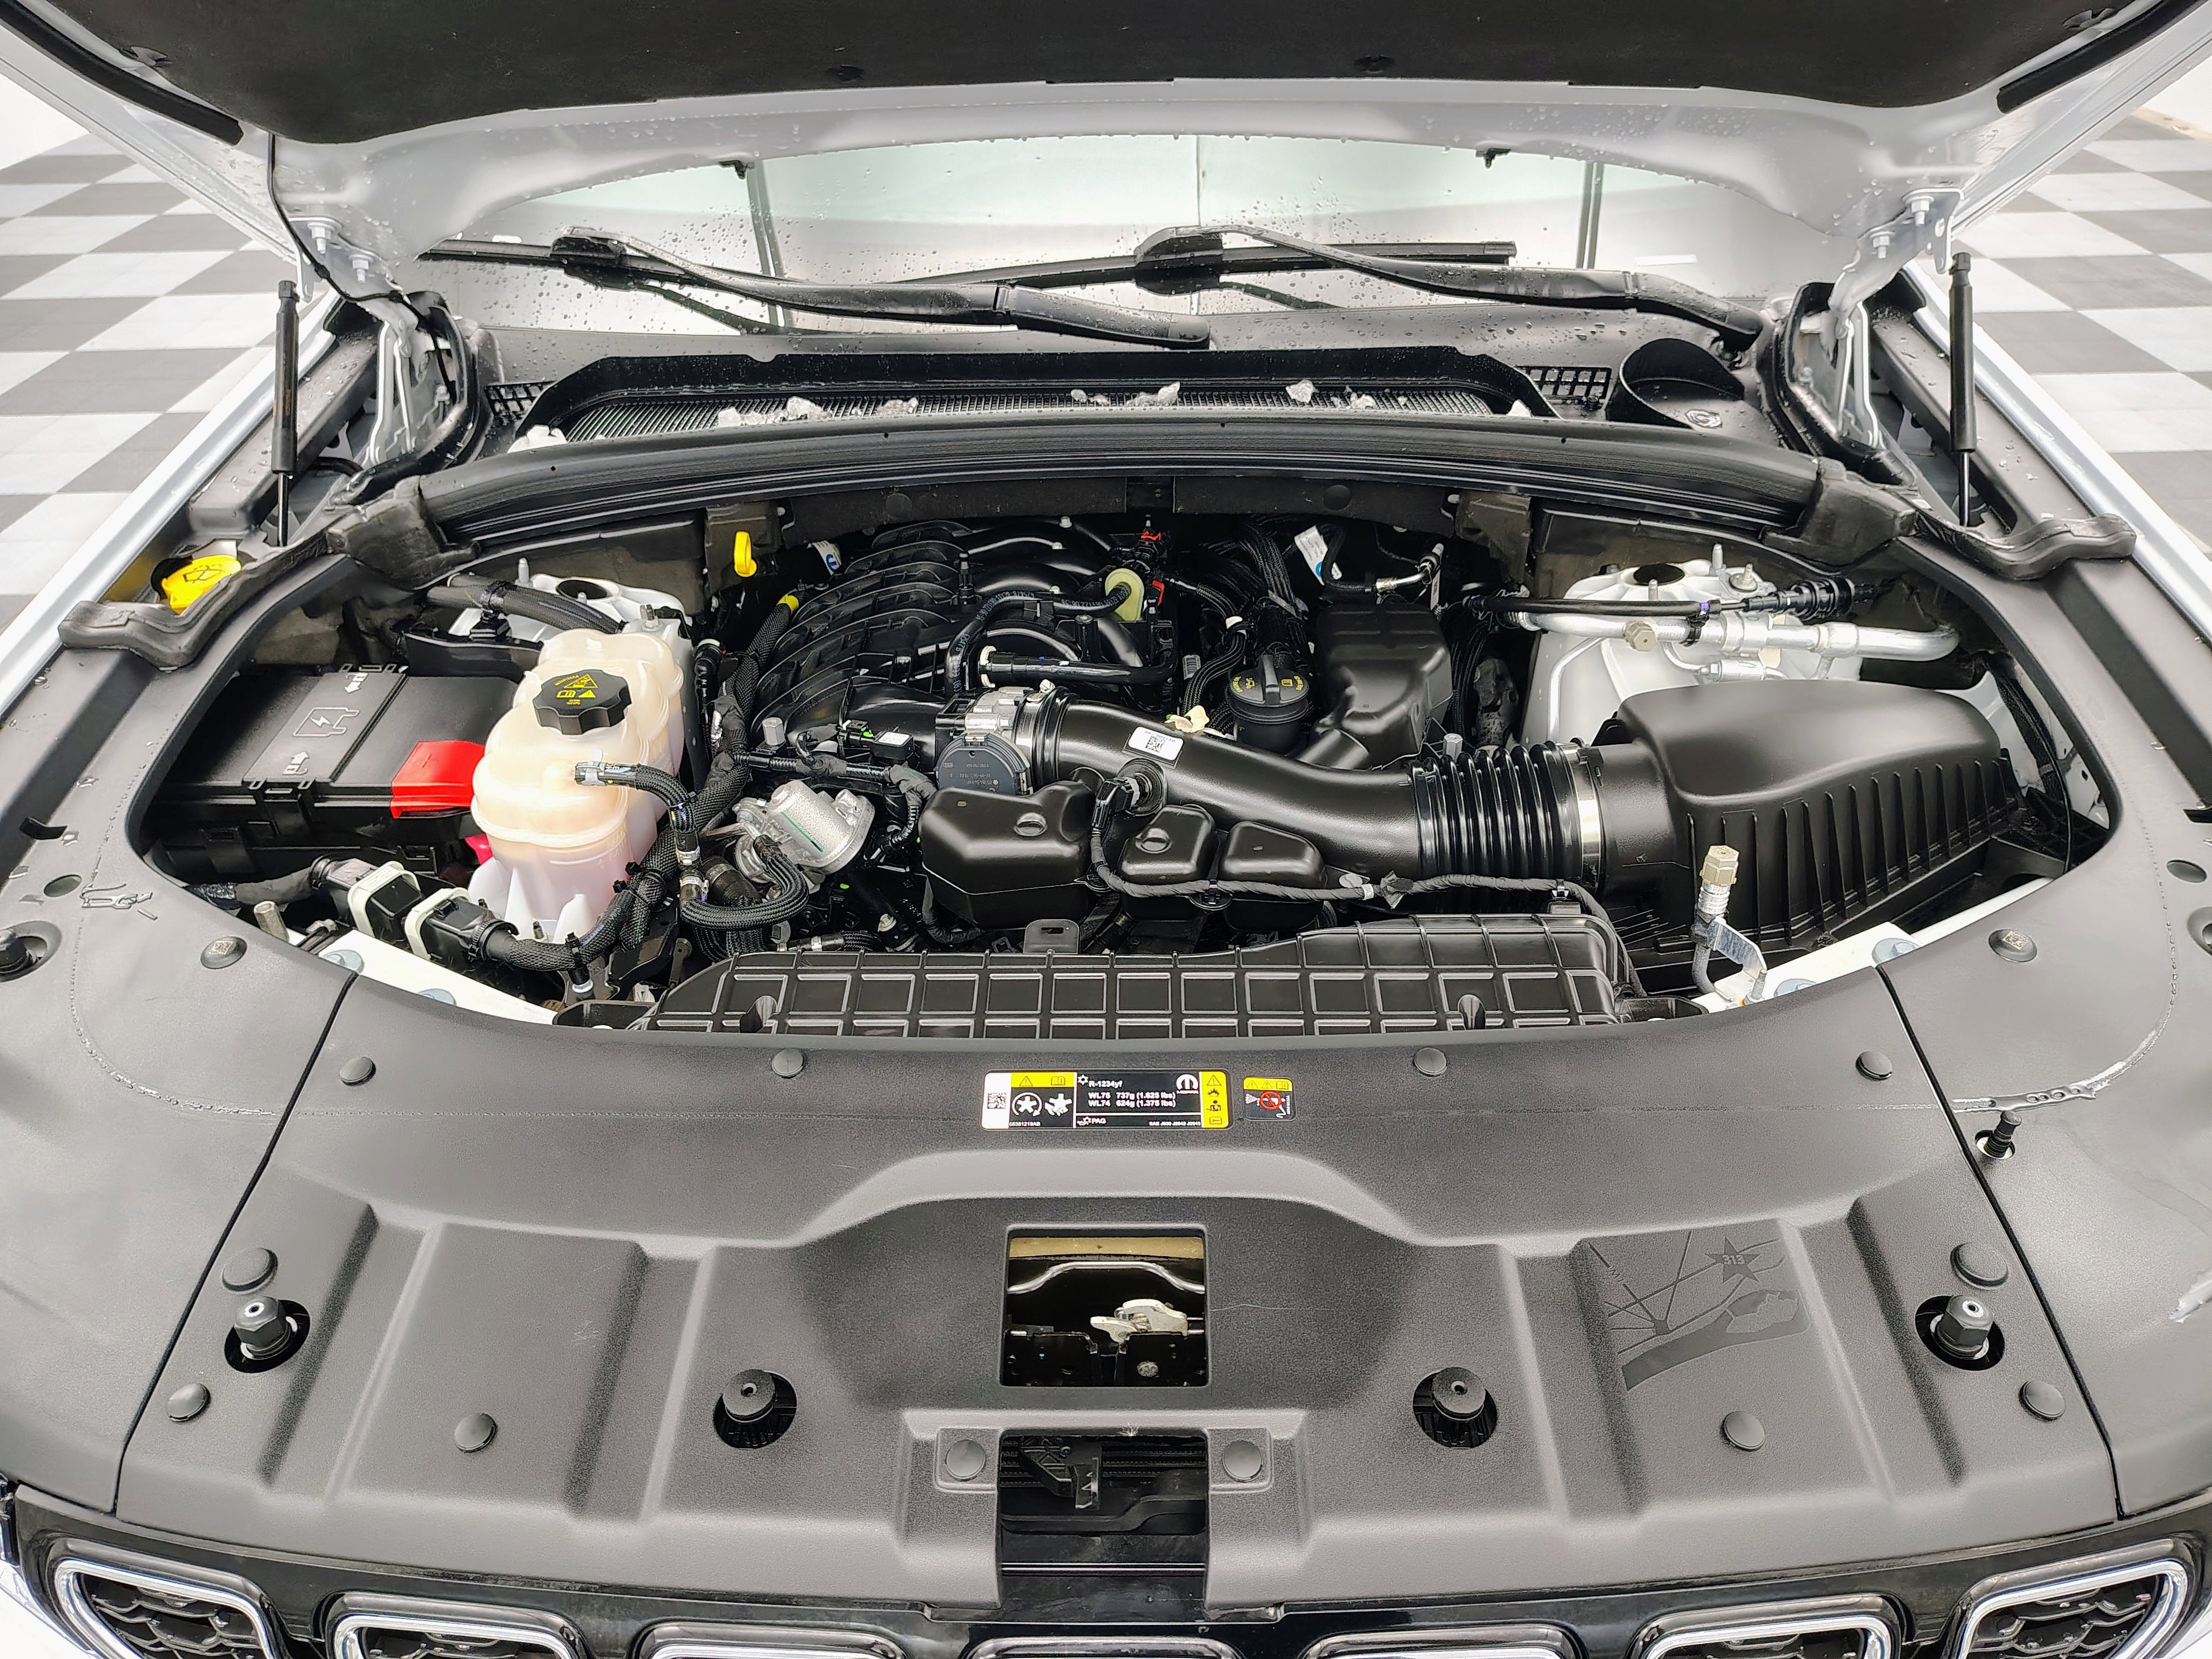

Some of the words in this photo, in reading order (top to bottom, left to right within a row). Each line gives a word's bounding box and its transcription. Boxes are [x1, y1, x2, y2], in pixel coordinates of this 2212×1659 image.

[1088, 1080, 1123, 1088] R-1234yf
[1116, 1092, 1135, 1100] 737g
[1161, 1092, 1176, 1100] lbs)
[1722, 1255, 1745, 1265] 313
